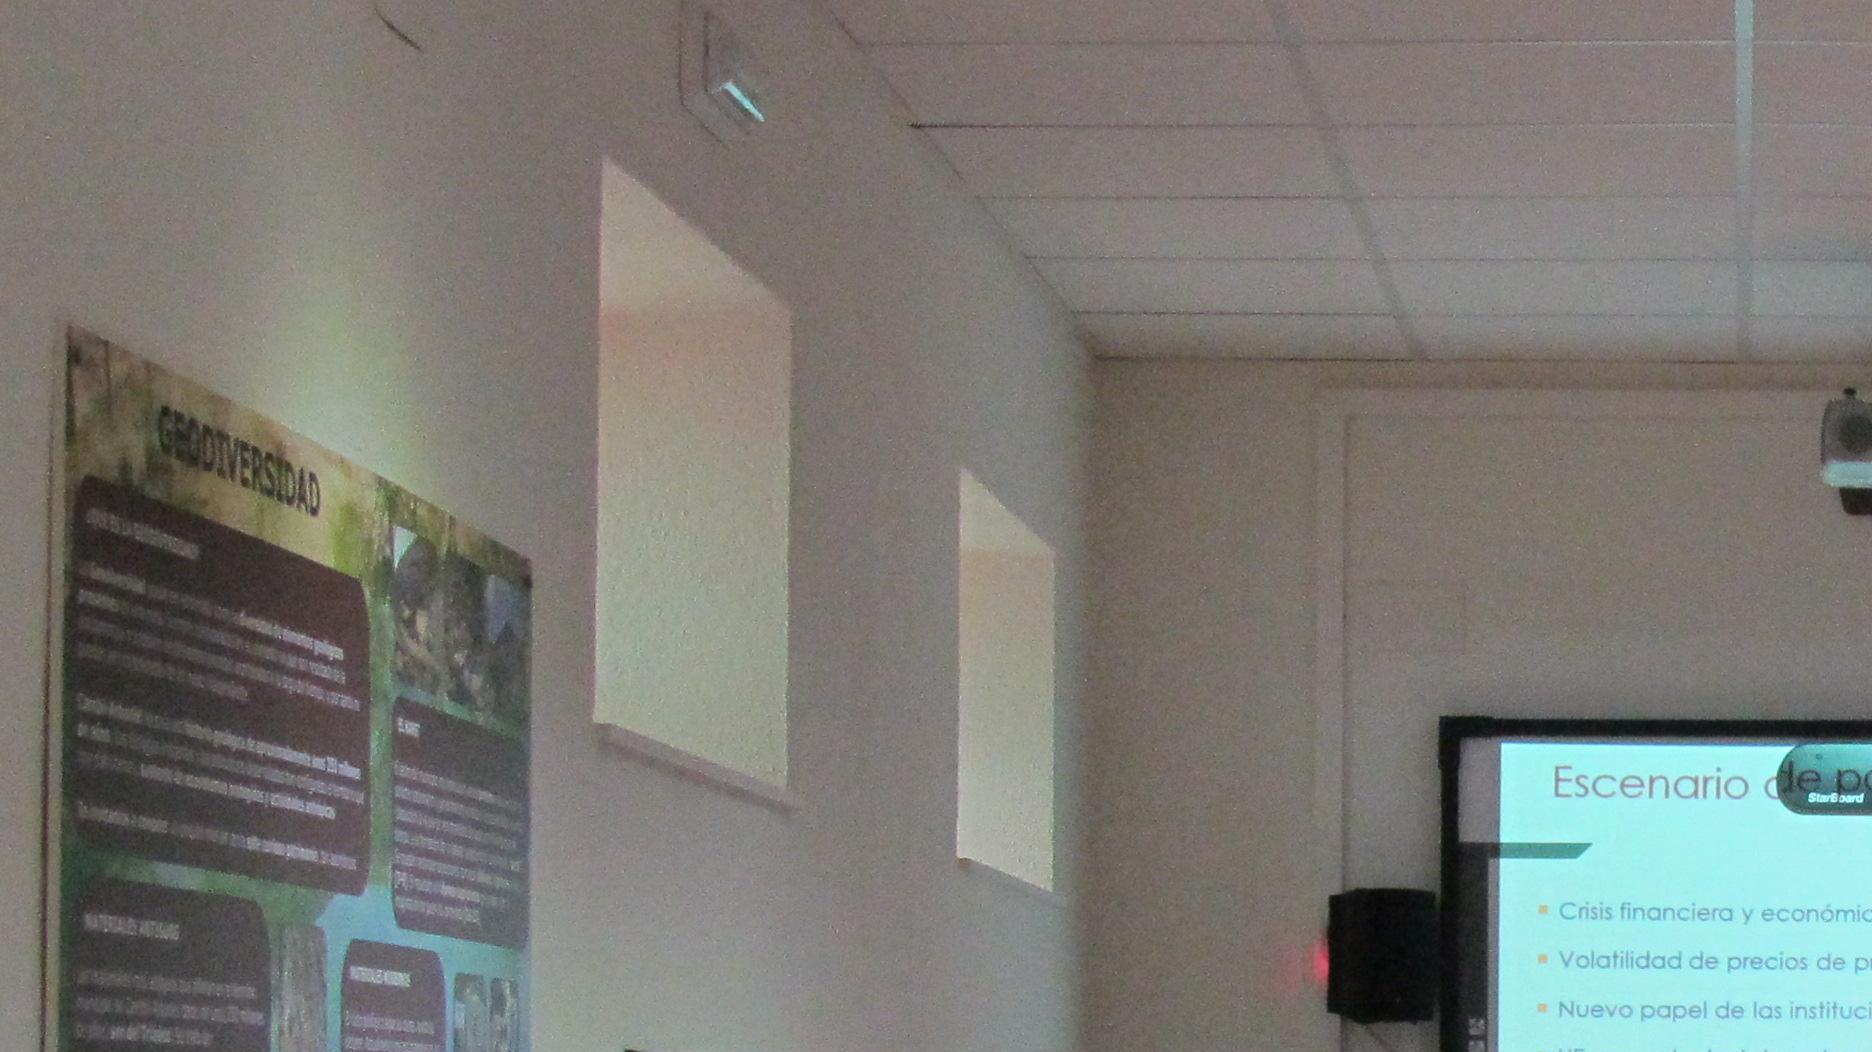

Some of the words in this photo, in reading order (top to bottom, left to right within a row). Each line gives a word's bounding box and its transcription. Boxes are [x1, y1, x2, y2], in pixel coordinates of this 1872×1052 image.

[159, 405, 321, 517] GEODIVERSIDAD
[1553, 765, 1750, 801] Escenario
[1763, 761, 1822, 796] de
[1559, 902, 1613, 922] Crisis
[1619, 902, 1734, 923] financiera
[1741, 907, 1754, 926] y
[1559, 951, 1682, 971] Volatilidad
[1689, 952, 1719, 972] de
[1727, 954, 1808, 974] precios
[1816, 953, 1847, 973] de
[1558, 1001, 1634, 1020] Nuevo
[1640, 1001, 1708, 1023] papel
[1715, 1001, 1745, 1020] de
[1753, 1001, 1782, 1020] las
